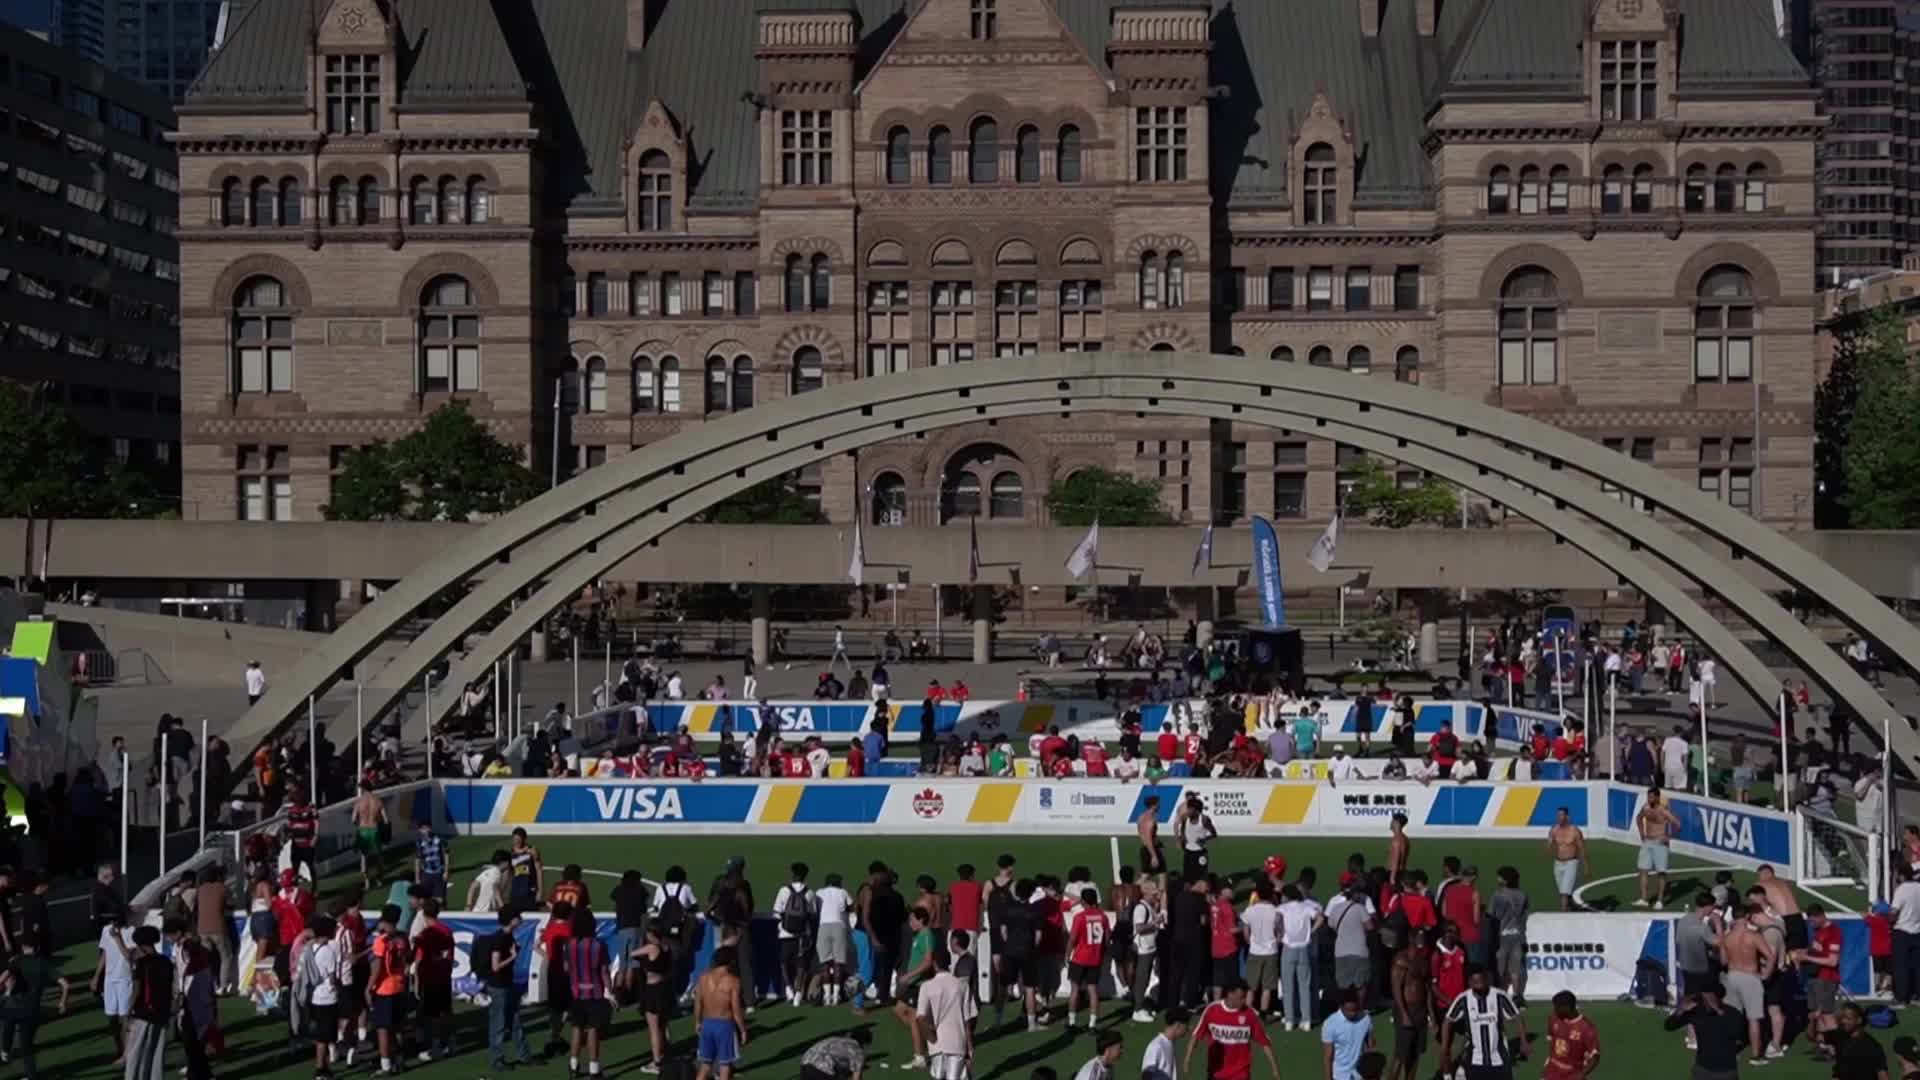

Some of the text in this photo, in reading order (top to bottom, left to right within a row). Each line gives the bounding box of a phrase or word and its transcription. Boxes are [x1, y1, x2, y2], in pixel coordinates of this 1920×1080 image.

[745, 707, 815, 731] VSA
[585, 787, 684, 820] VISA
[1213, 800, 1248, 808] SOCCER
[1343, 794, 1369, 805] WE
[1696, 806, 1756, 854] VISA
[1086, 922, 1104, 945] 19
[1527, 955, 1606, 970] RONTO
